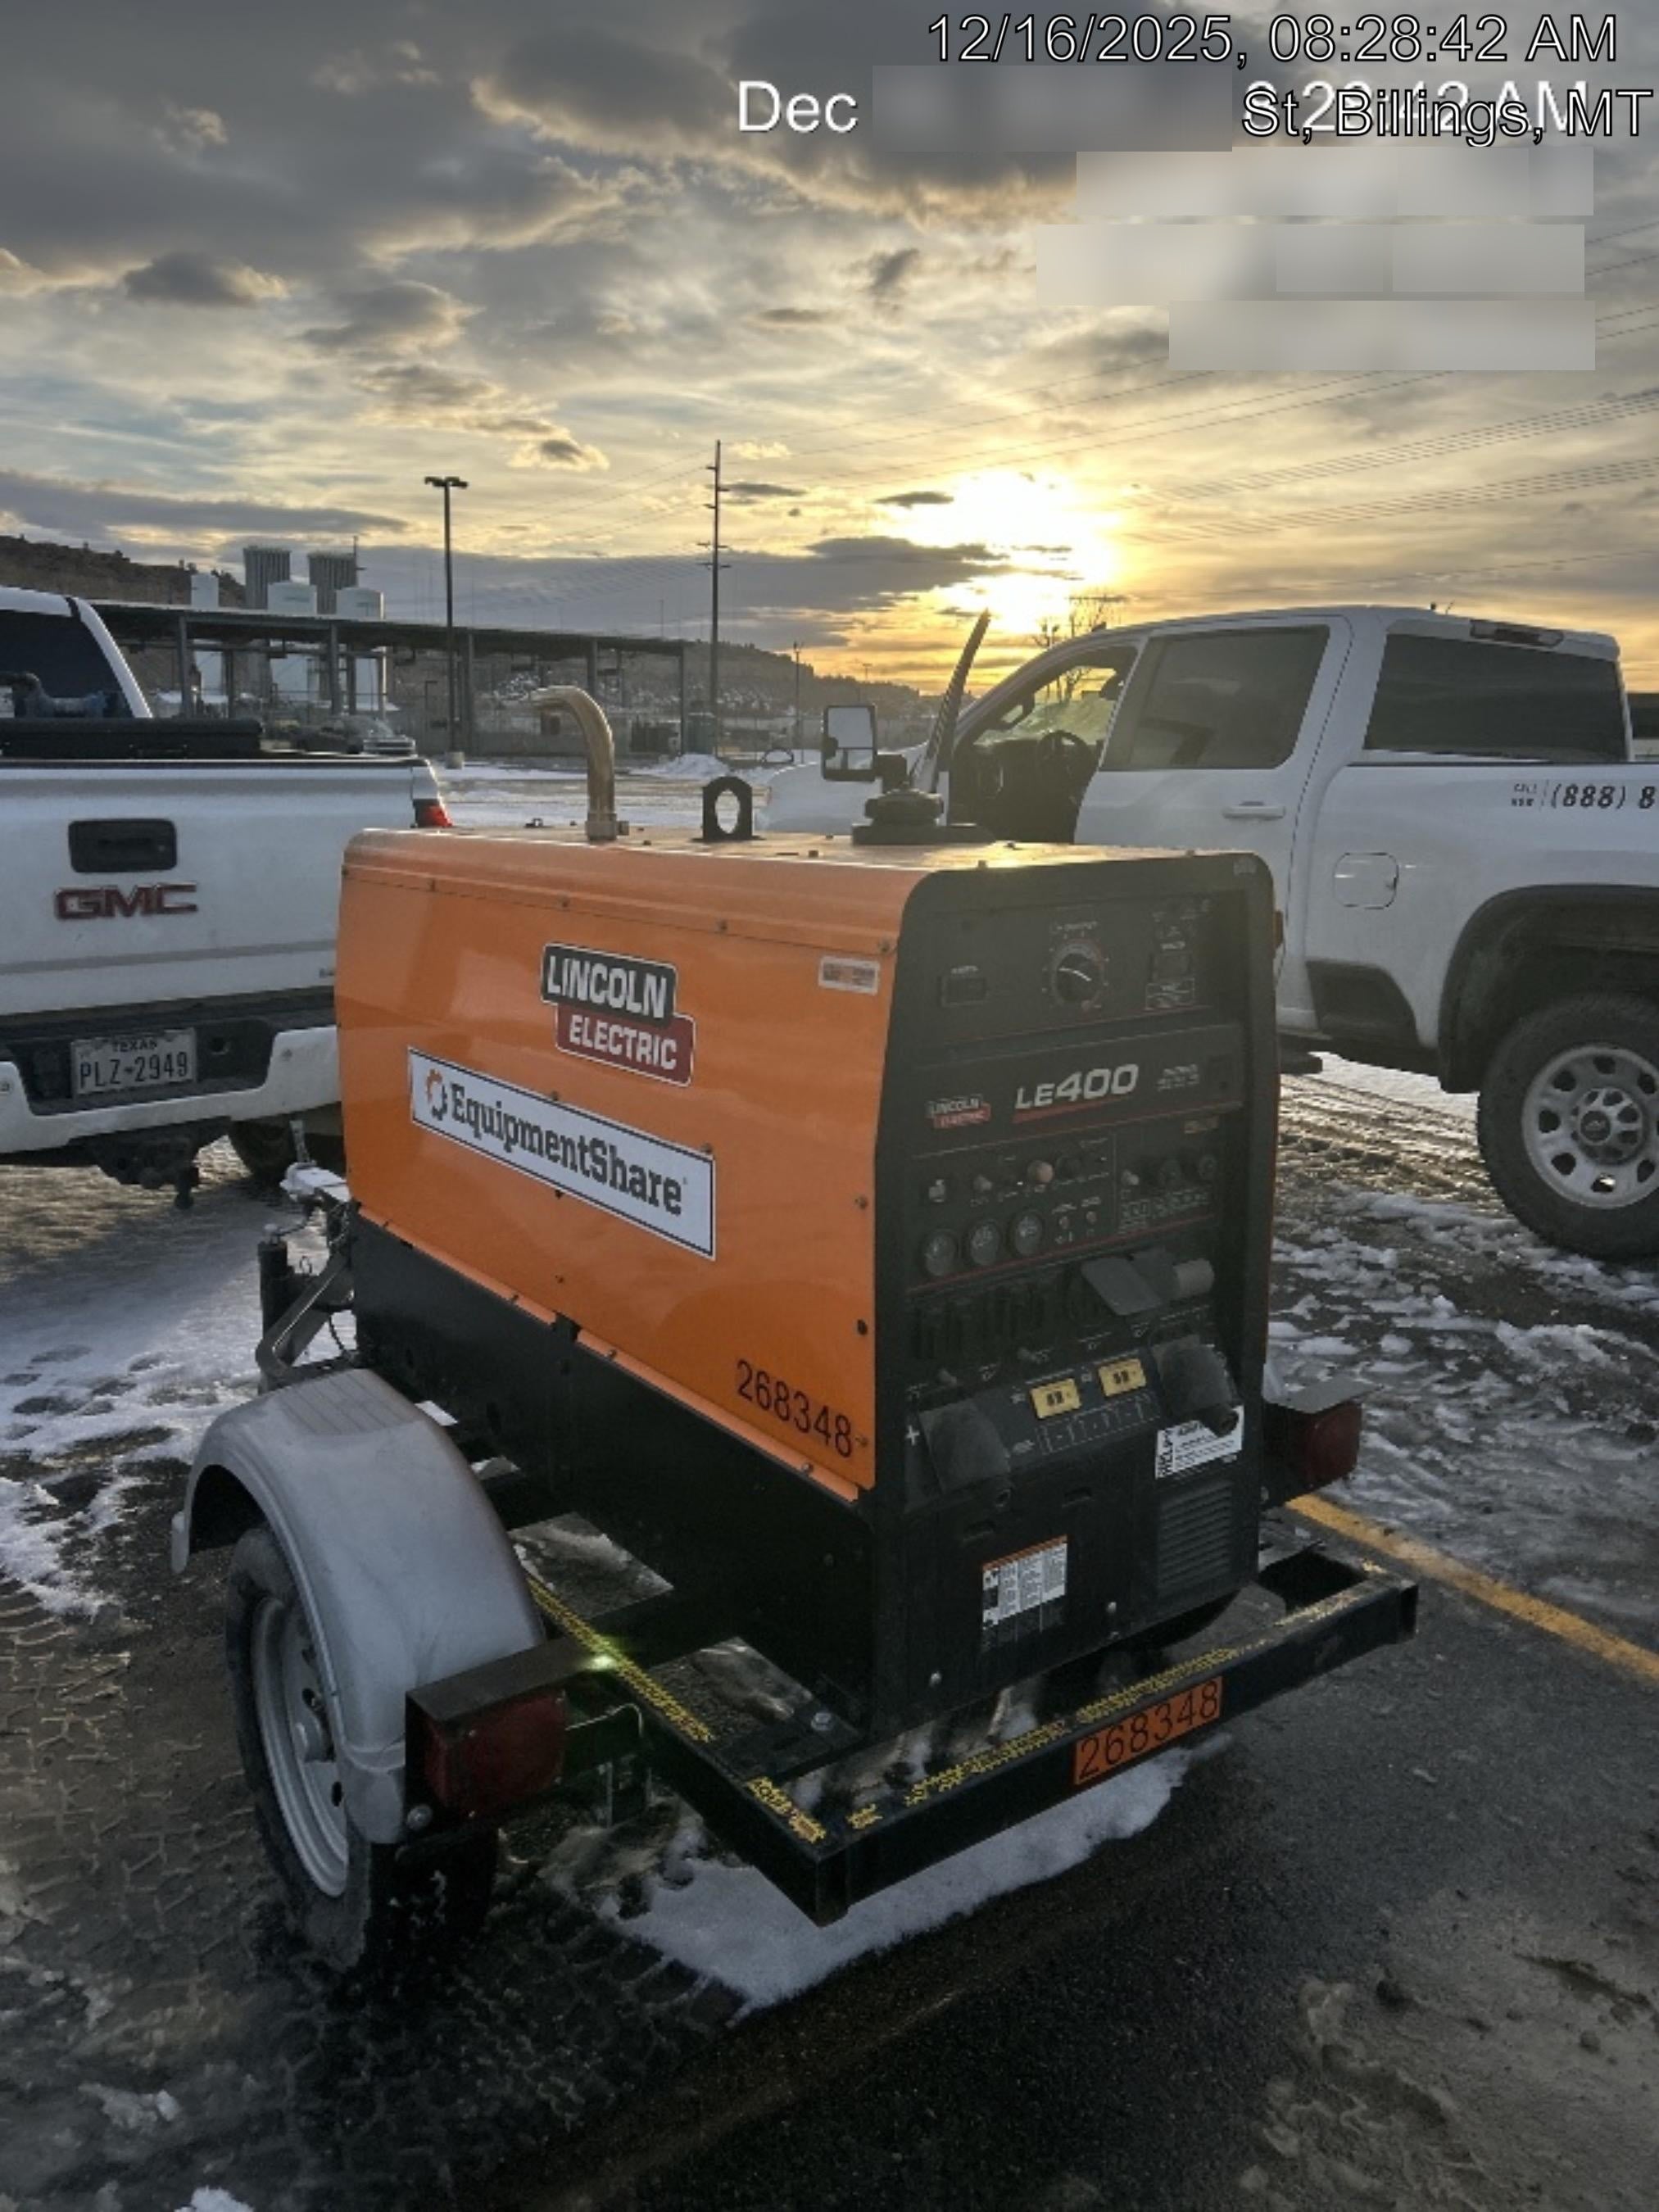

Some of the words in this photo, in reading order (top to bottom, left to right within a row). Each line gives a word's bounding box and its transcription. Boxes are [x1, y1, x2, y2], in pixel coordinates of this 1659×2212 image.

[1551, 783, 1626, 809] (888)
[55, 882, 198, 919] GMC
[547, 955, 667, 1018] LINCOLN
[111, 1034, 158, 1053] TEXAS
[569, 1014, 678, 1070] ELECTRIC
[1014, 1064, 1140, 1109] LE400
[451, 1082, 682, 1217] EquipmentShare
[737, 1358, 852, 1458] 268348
[1078, 1680, 1218, 1780] 268348
